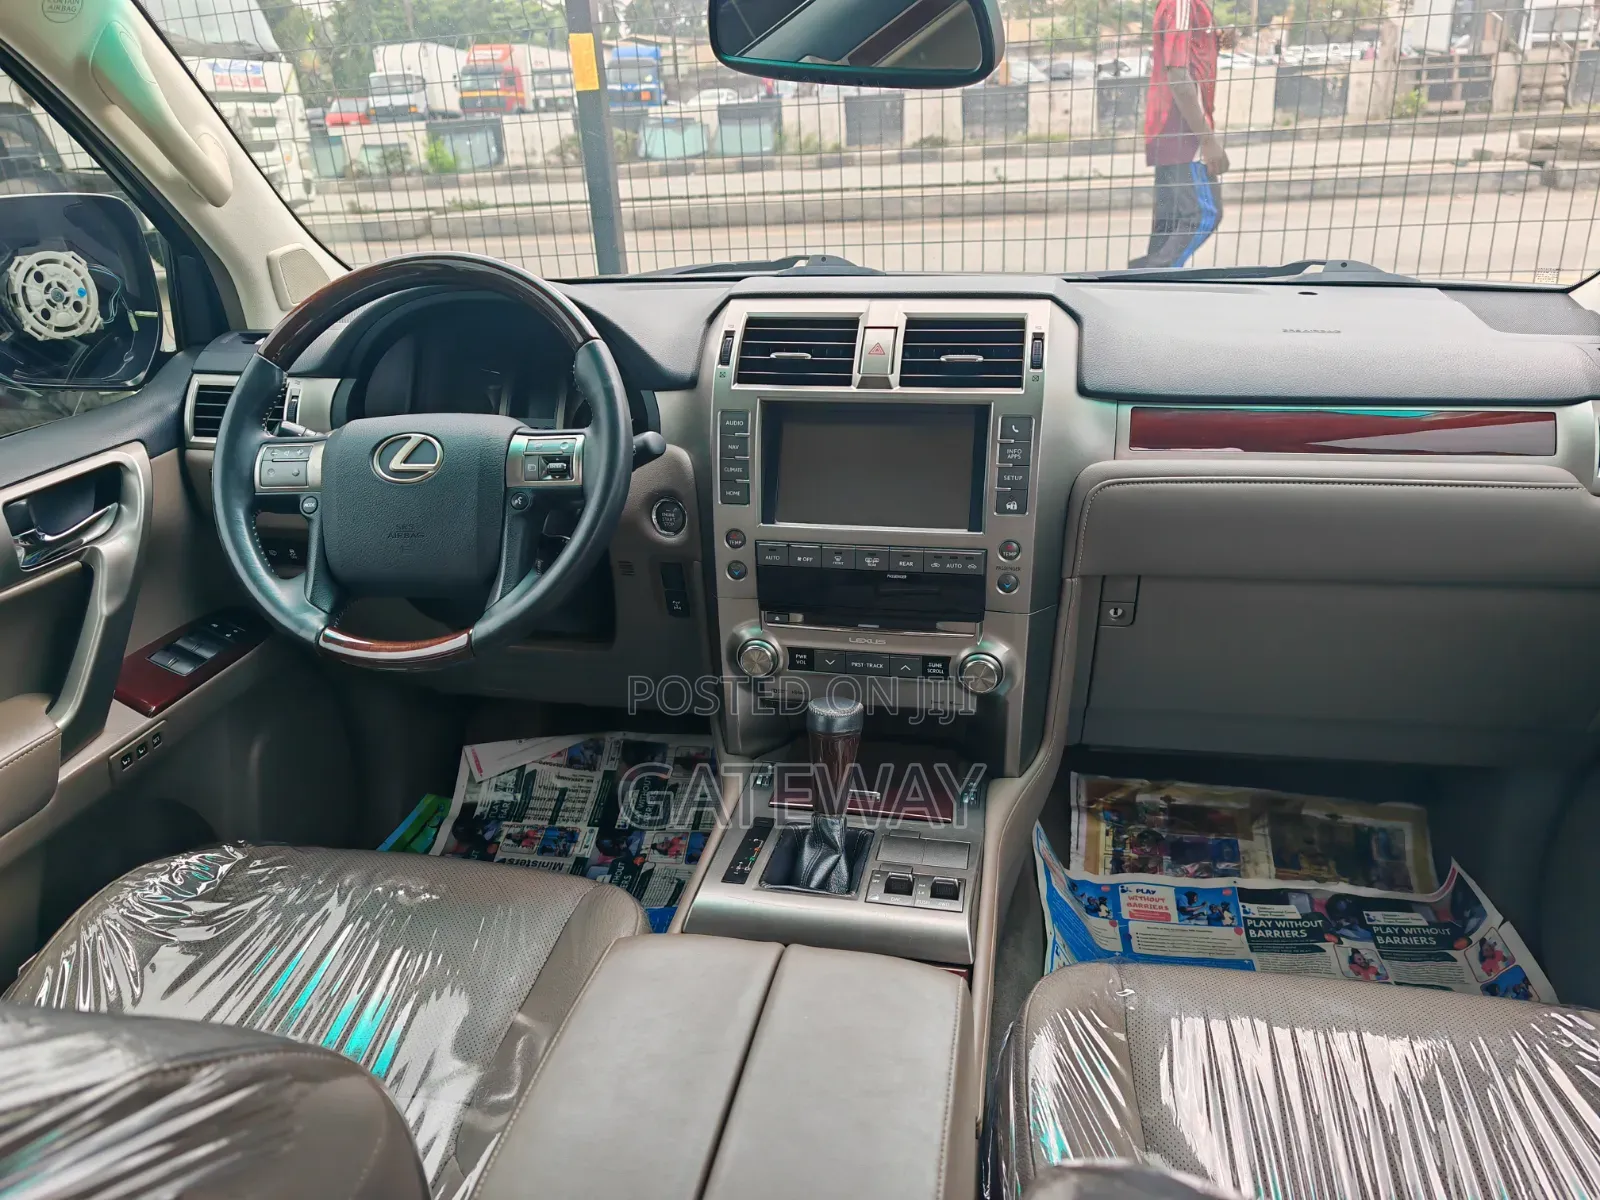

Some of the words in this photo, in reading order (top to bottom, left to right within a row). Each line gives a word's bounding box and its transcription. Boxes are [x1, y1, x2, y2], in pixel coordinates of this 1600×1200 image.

[48, 4, 77, 12] AIRBAG
[848, 637, 886, 645] LEXUS
[507, 857, 565, 871] Ministers
[1127, 895, 1166, 903] WITHOUT
[1126, 903, 1169, 911] BARRIERS
[1247, 919, 1273, 928] PLAY
[1275, 919, 1323, 928] WITHOUT
[1249, 929, 1308, 938] BARRIERS
[1372, 926, 1400, 934] PLAY
[1401, 926, 1452, 936] WITHOUT
[1376, 936, 1437, 945] BARRIERS
